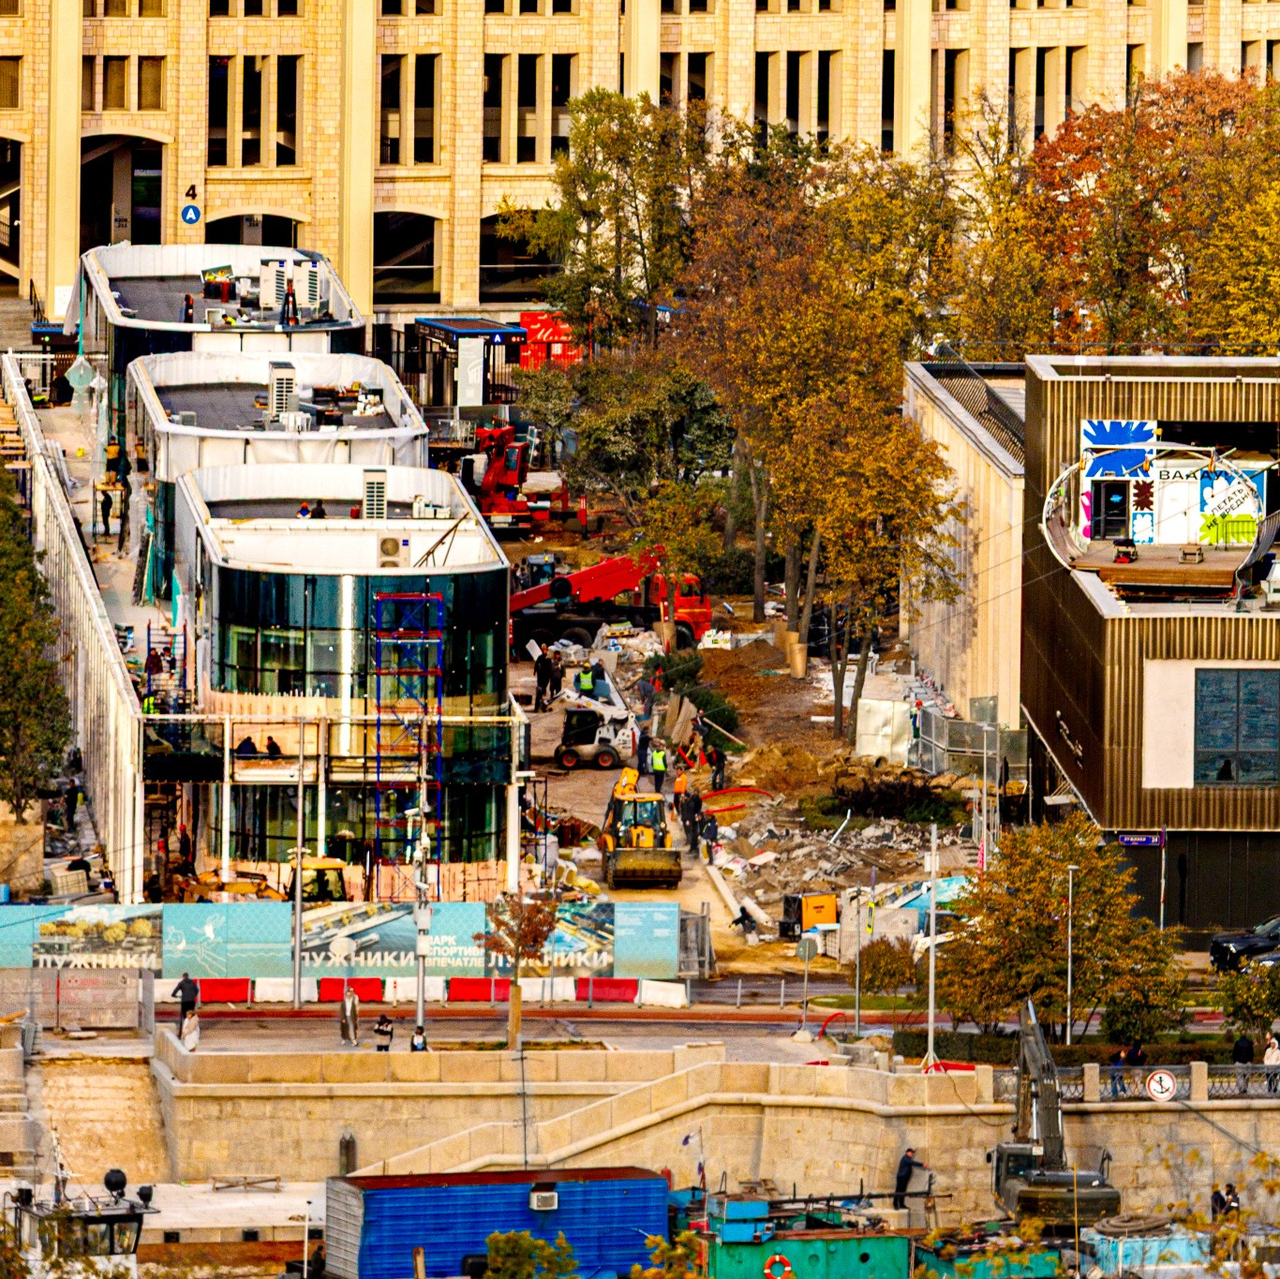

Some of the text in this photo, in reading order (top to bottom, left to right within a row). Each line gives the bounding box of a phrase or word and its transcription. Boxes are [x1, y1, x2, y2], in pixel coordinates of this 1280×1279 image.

[185, 184, 197, 200] 4
[1211, 488, 1244, 516] ЛЕТАТЬ
[1220, 491, 1251, 520] ВРЕДН
